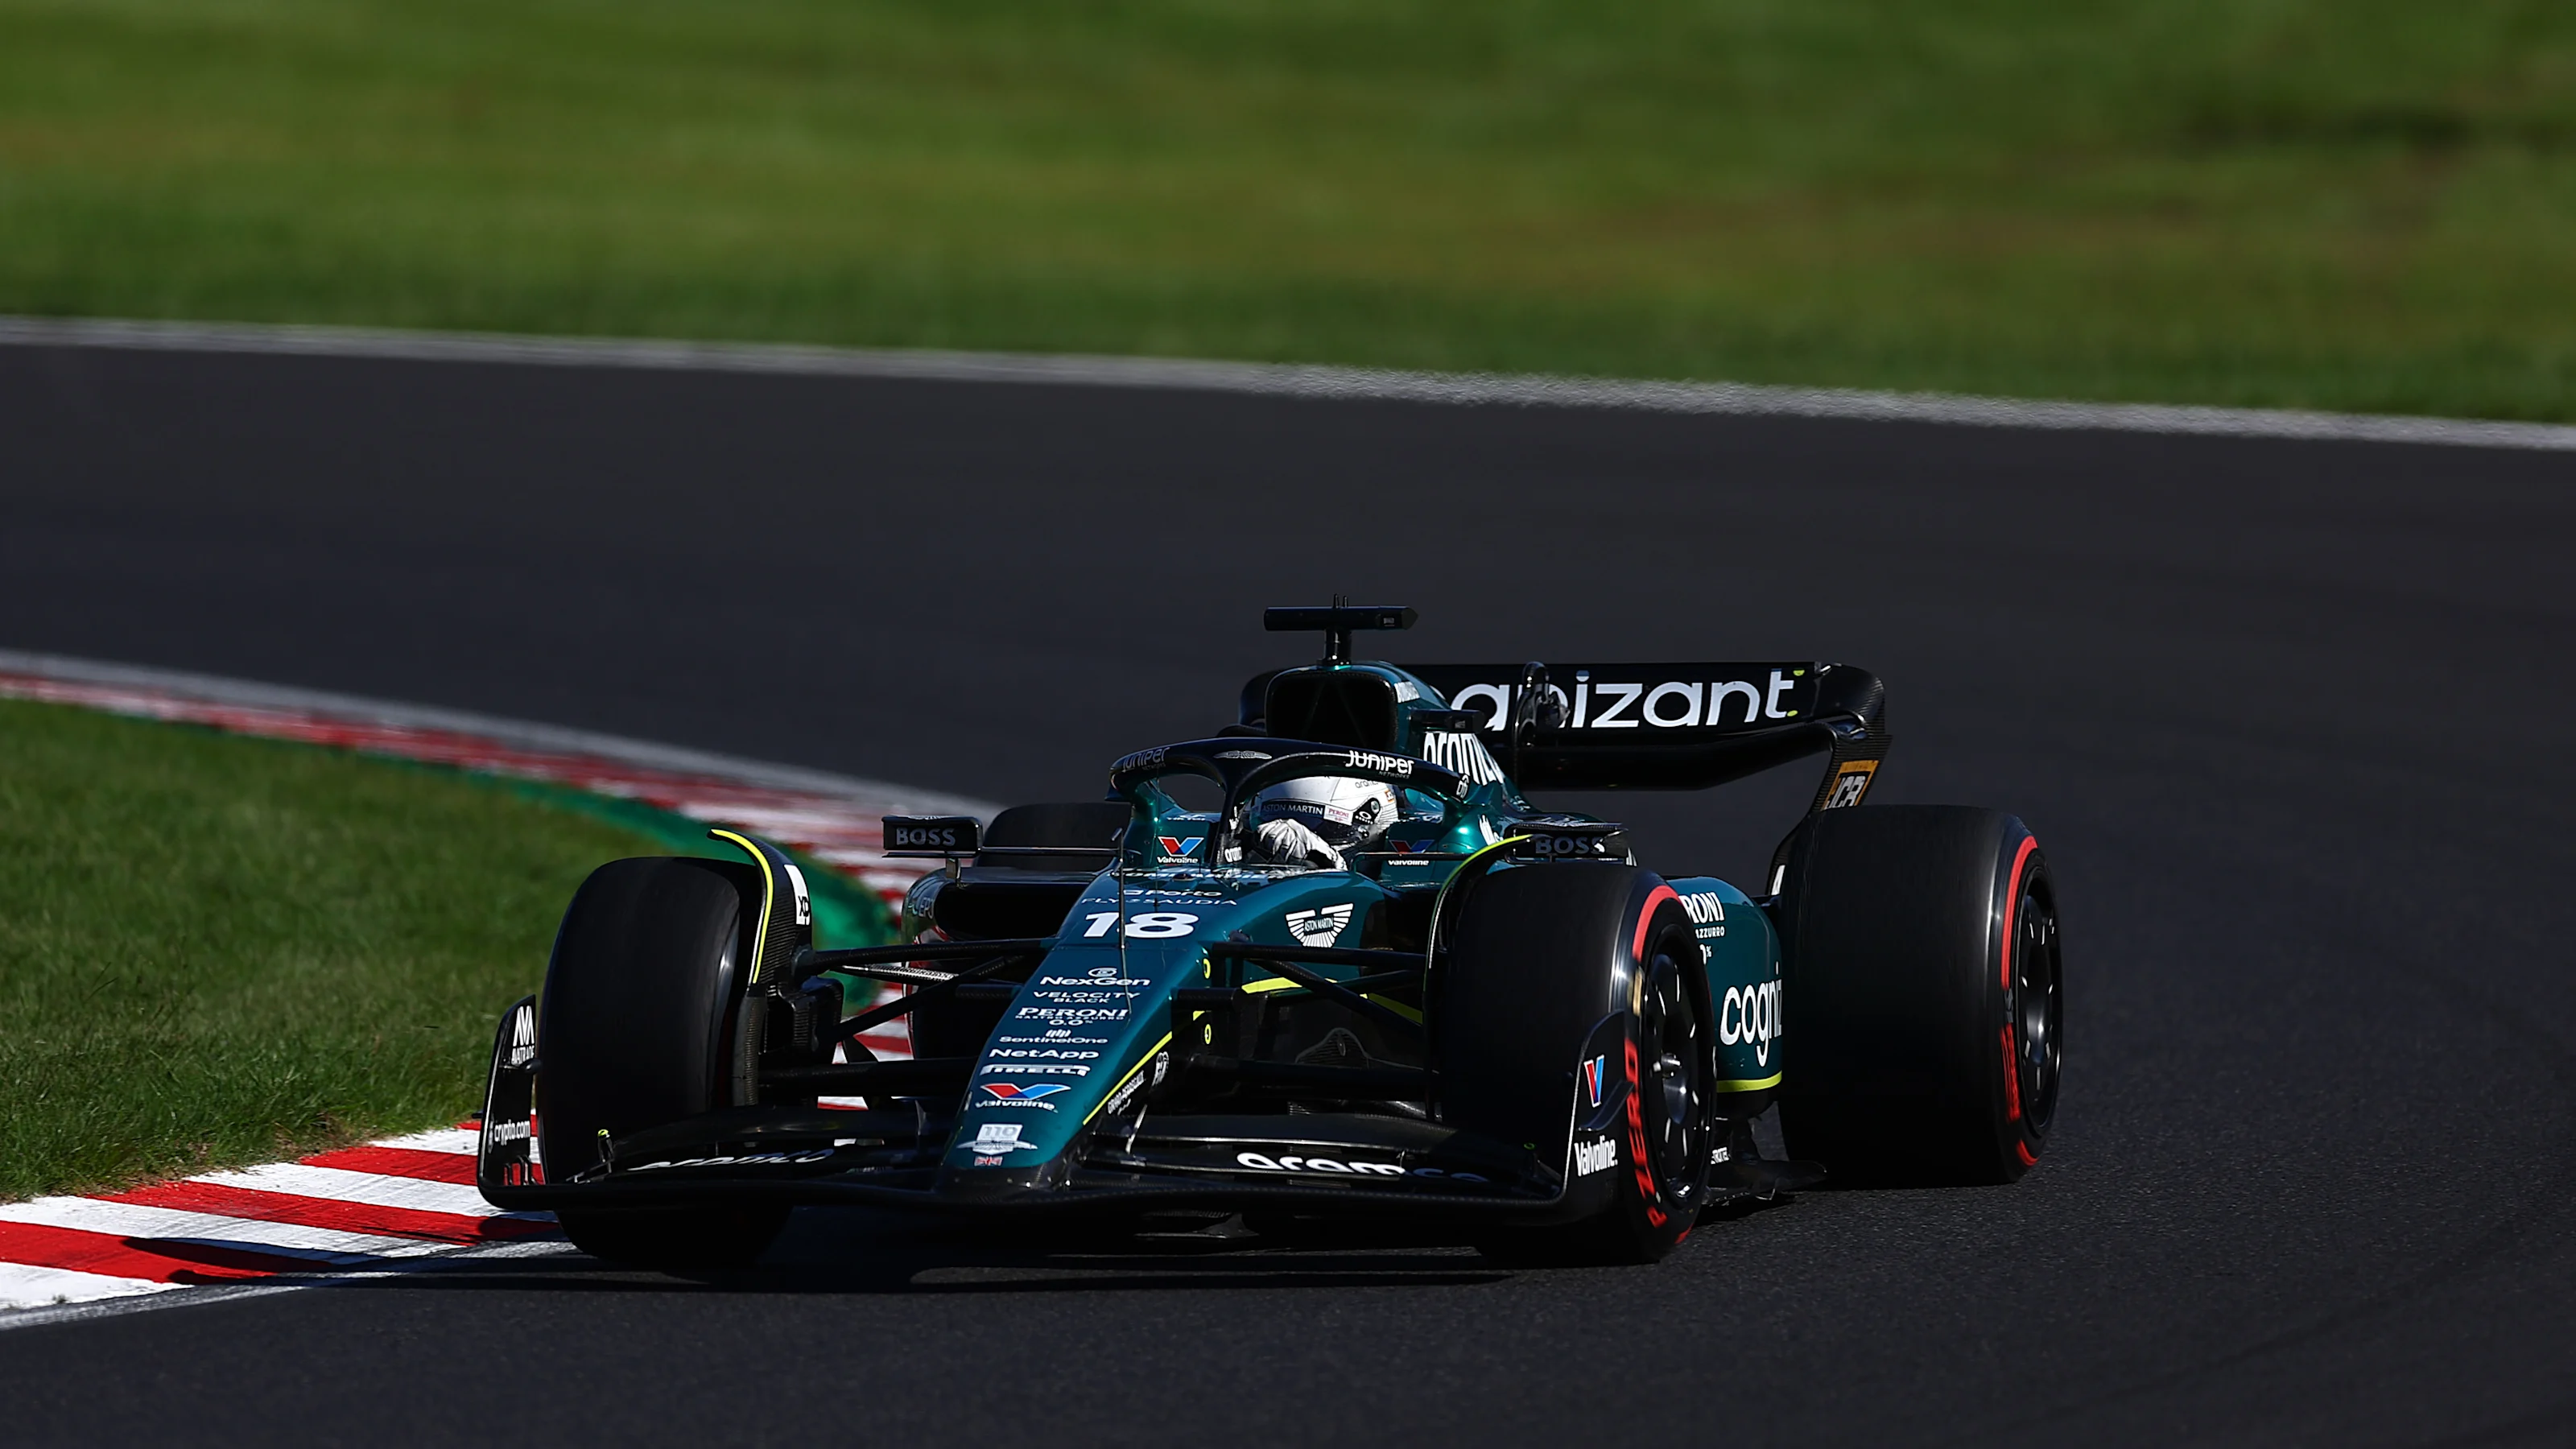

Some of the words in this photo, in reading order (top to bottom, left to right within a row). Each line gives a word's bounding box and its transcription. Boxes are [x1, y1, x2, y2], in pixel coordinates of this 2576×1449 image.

[1288, 805, 1323, 815] MARTIN
[1329, 808, 1349, 817] PERONI
[896, 828, 956, 846] BOSS
[1535, 836, 1605, 854] BOSS
[1157, 856, 1198, 864] Valvoline
[1146, 890, 1222, 898] Porto
[1143, 898, 1237, 906] SAUDIA
[1084, 911, 1199, 939] 18
[1040, 976, 1150, 987] NexGen
[1033, 991, 1141, 999] VELOCITY
[1018, 1007, 1129, 1017] PERONI
[999, 1035, 1108, 1045] SentinelOne
[989, 1048, 1100, 1059] NetApp
[980, 1063, 1091, 1077] PIRELLI
[1624, 1037, 1657, 1200] ZERO
[494, 1119, 530, 1146] crypto.com
